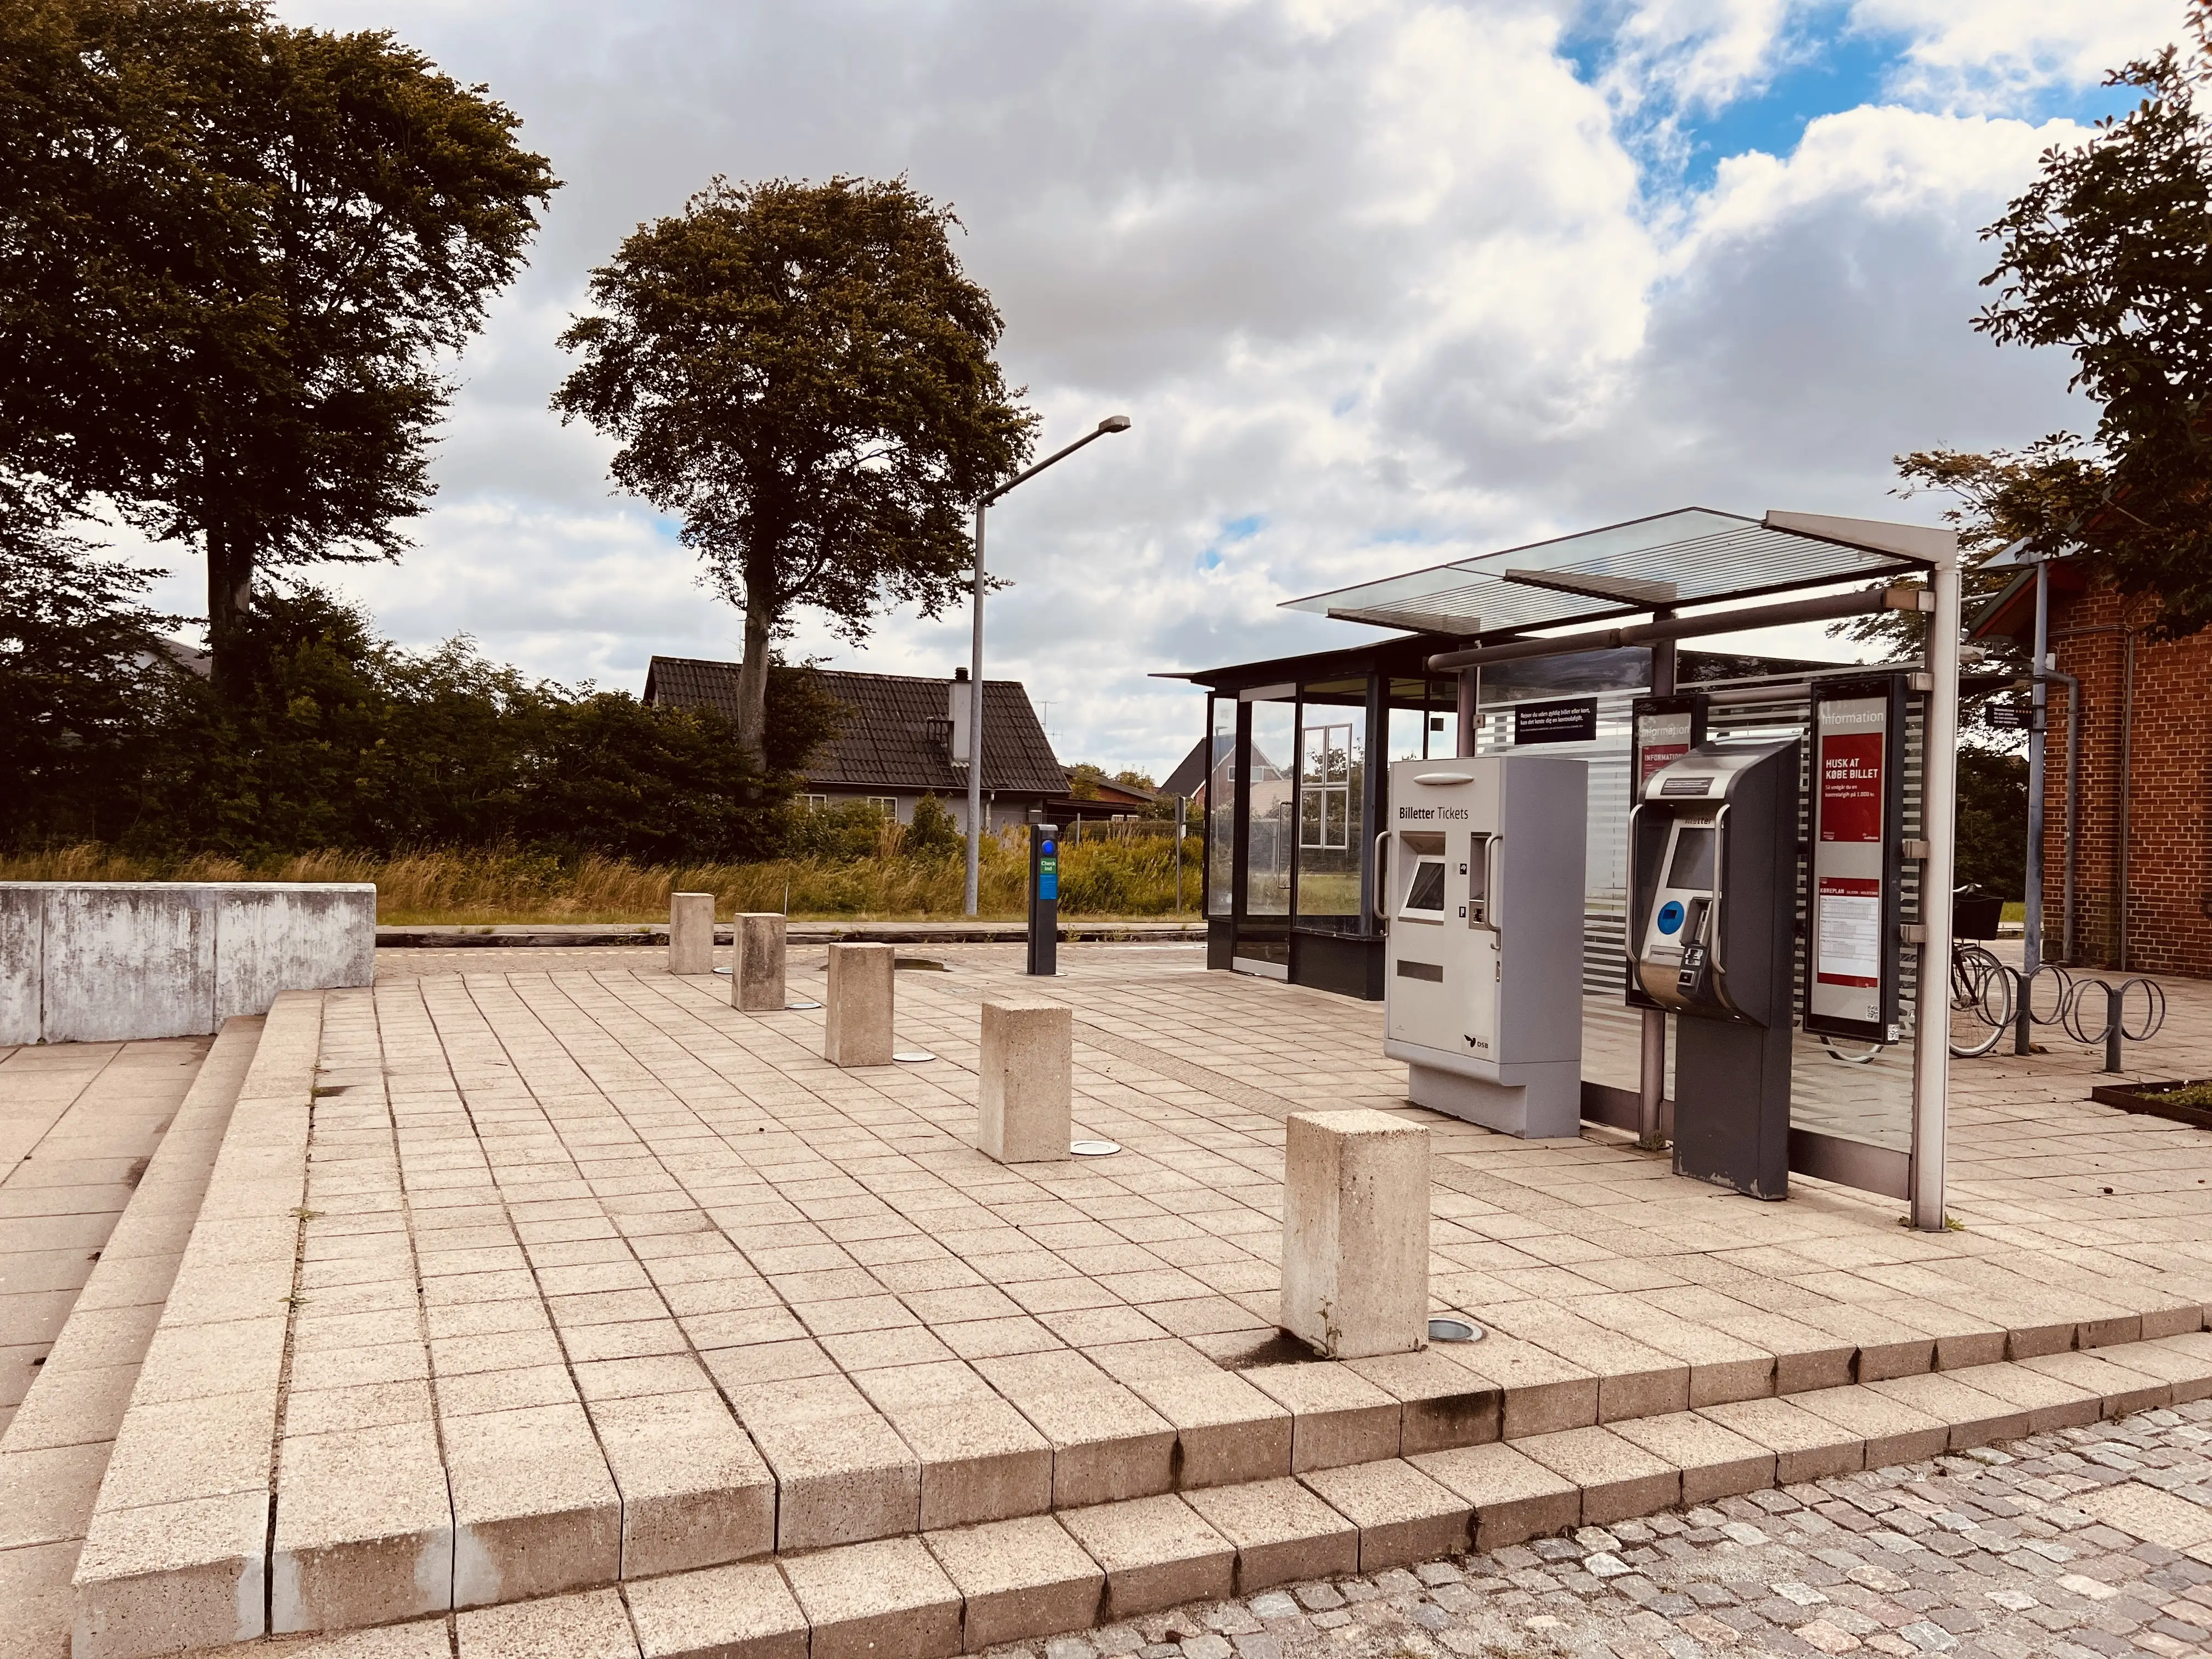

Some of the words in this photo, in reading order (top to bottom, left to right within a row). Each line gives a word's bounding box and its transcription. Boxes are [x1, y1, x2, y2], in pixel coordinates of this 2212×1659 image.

[1822, 711, 1884, 725] Information
[1826, 759, 1848, 768] HUSK
[1849, 758, 1860, 768] AT
[1826, 770, 1848, 779] KØBE
[1849, 769, 1878, 778] BILLET
[1400, 806, 1435, 819] Billetter
[1437, 806, 1468, 820] Tickets
